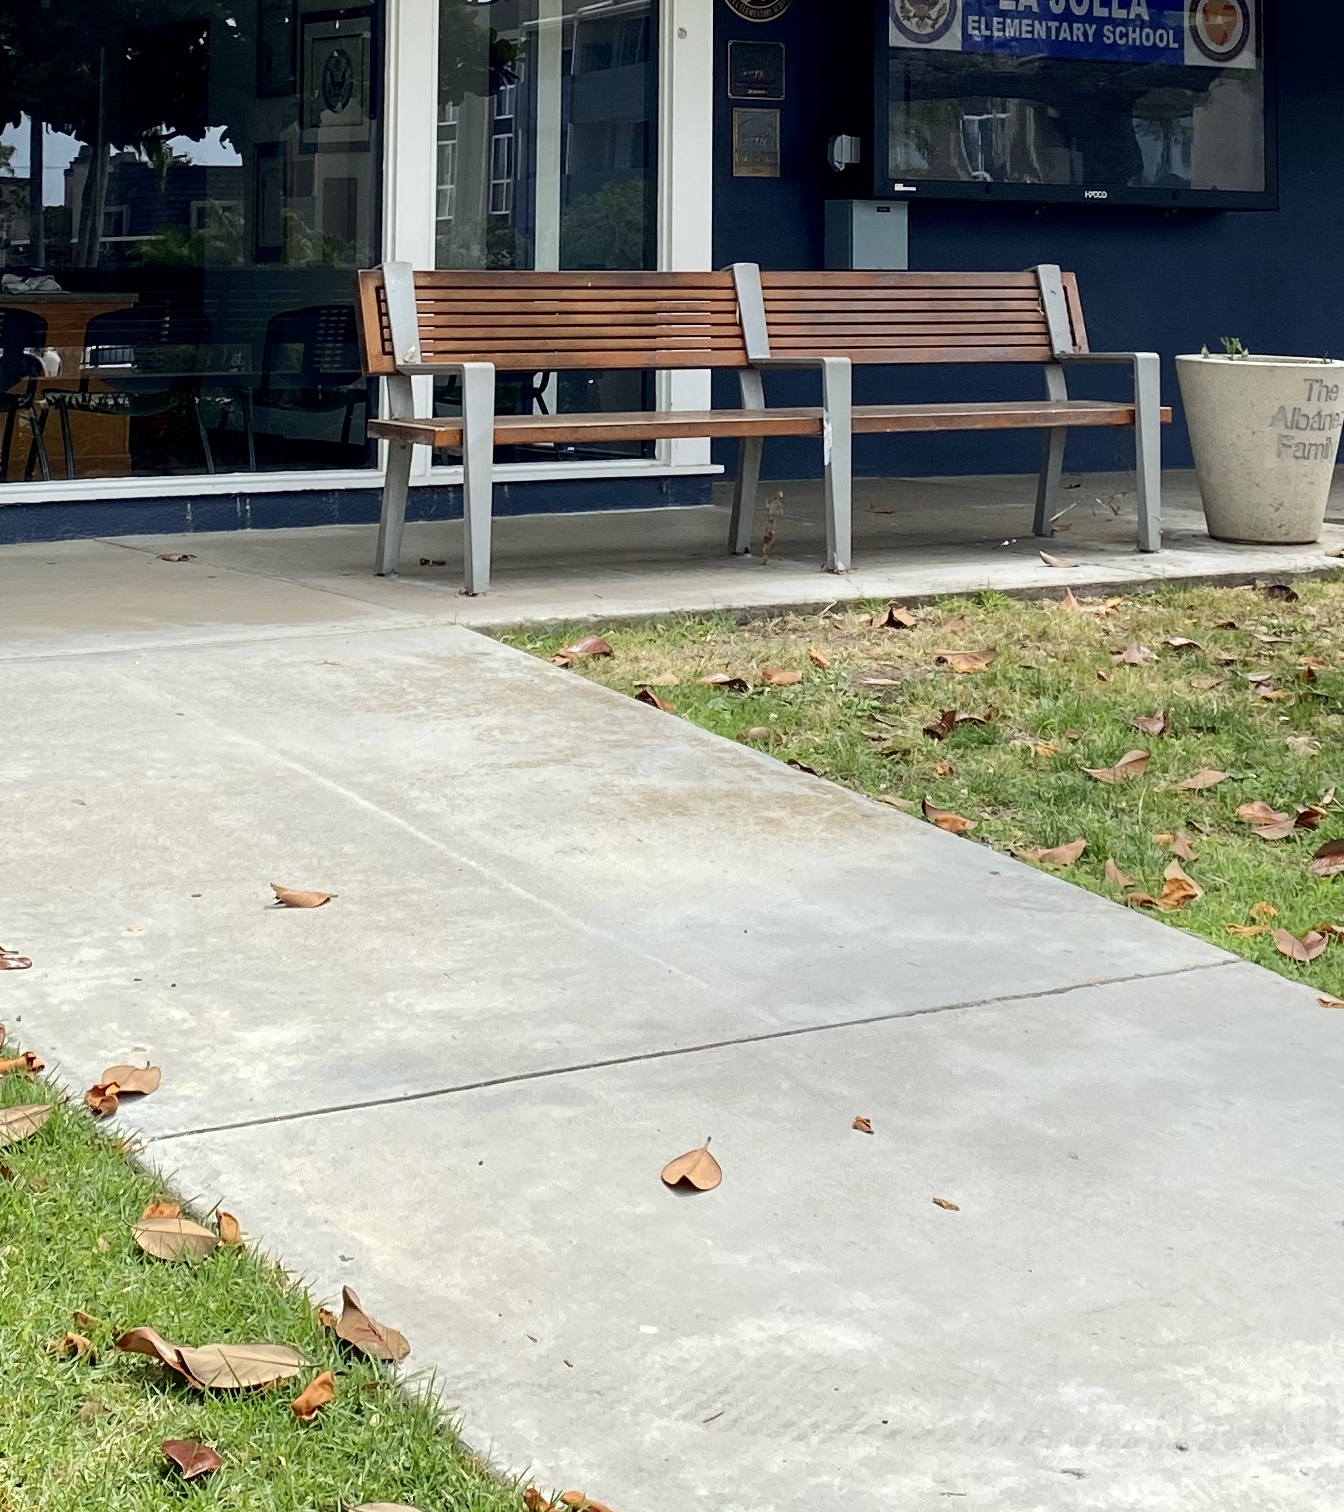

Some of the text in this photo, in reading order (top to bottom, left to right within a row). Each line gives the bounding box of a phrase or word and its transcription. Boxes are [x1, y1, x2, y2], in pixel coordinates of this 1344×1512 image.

[967, 15, 1179, 49] ELEMENTARY SCHOOL
[1303, 378, 1339, 402] The
